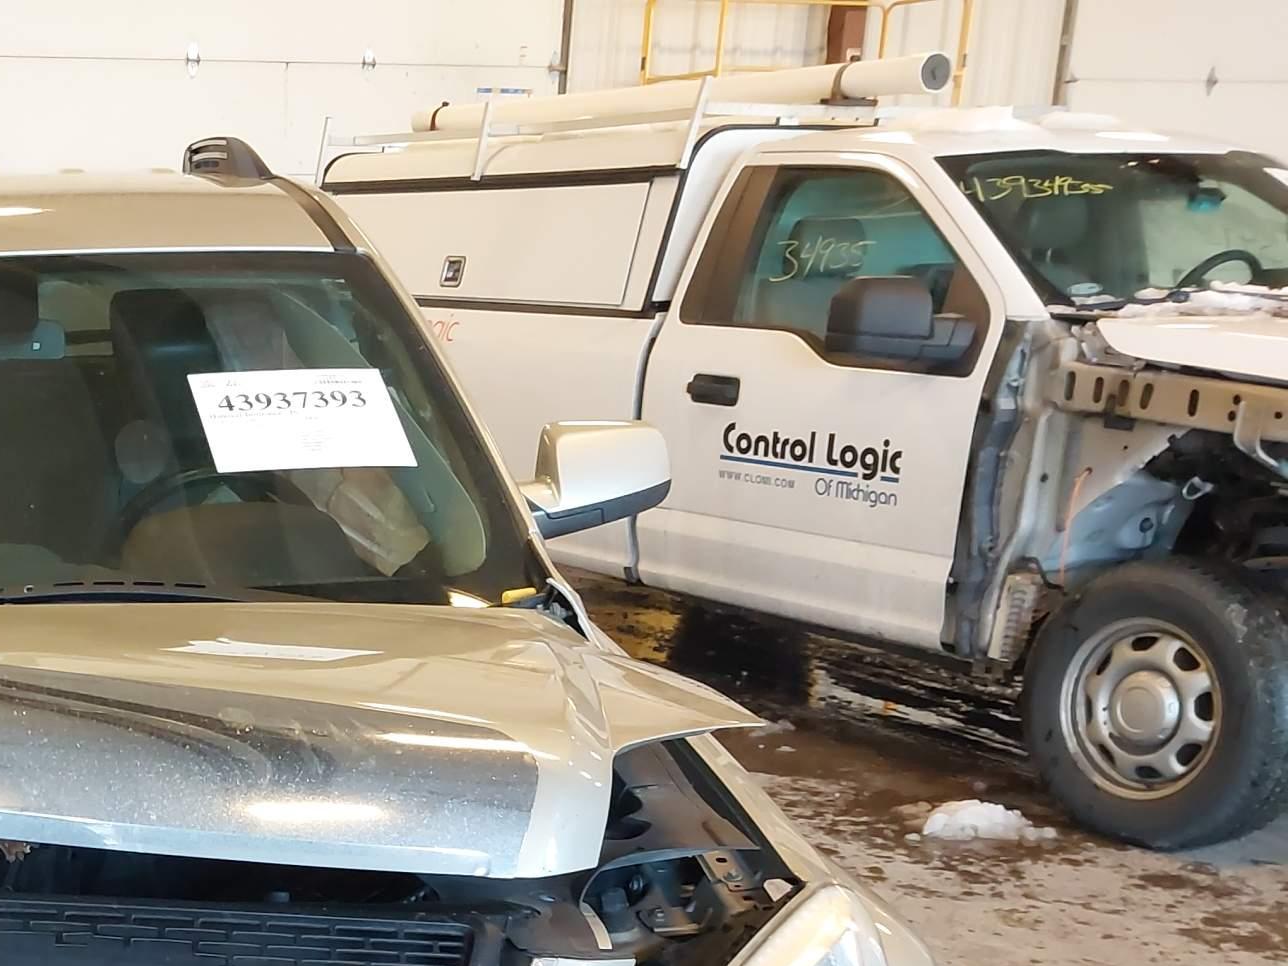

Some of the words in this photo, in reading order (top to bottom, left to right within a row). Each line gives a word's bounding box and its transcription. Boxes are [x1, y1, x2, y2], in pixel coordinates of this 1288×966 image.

[218, 390, 367, 412] 43937393
[722, 421, 817, 464] Control
[826, 433, 903, 481] Logic
[814, 477, 834, 497] Of
[835, 480, 898, 508] Michigan
